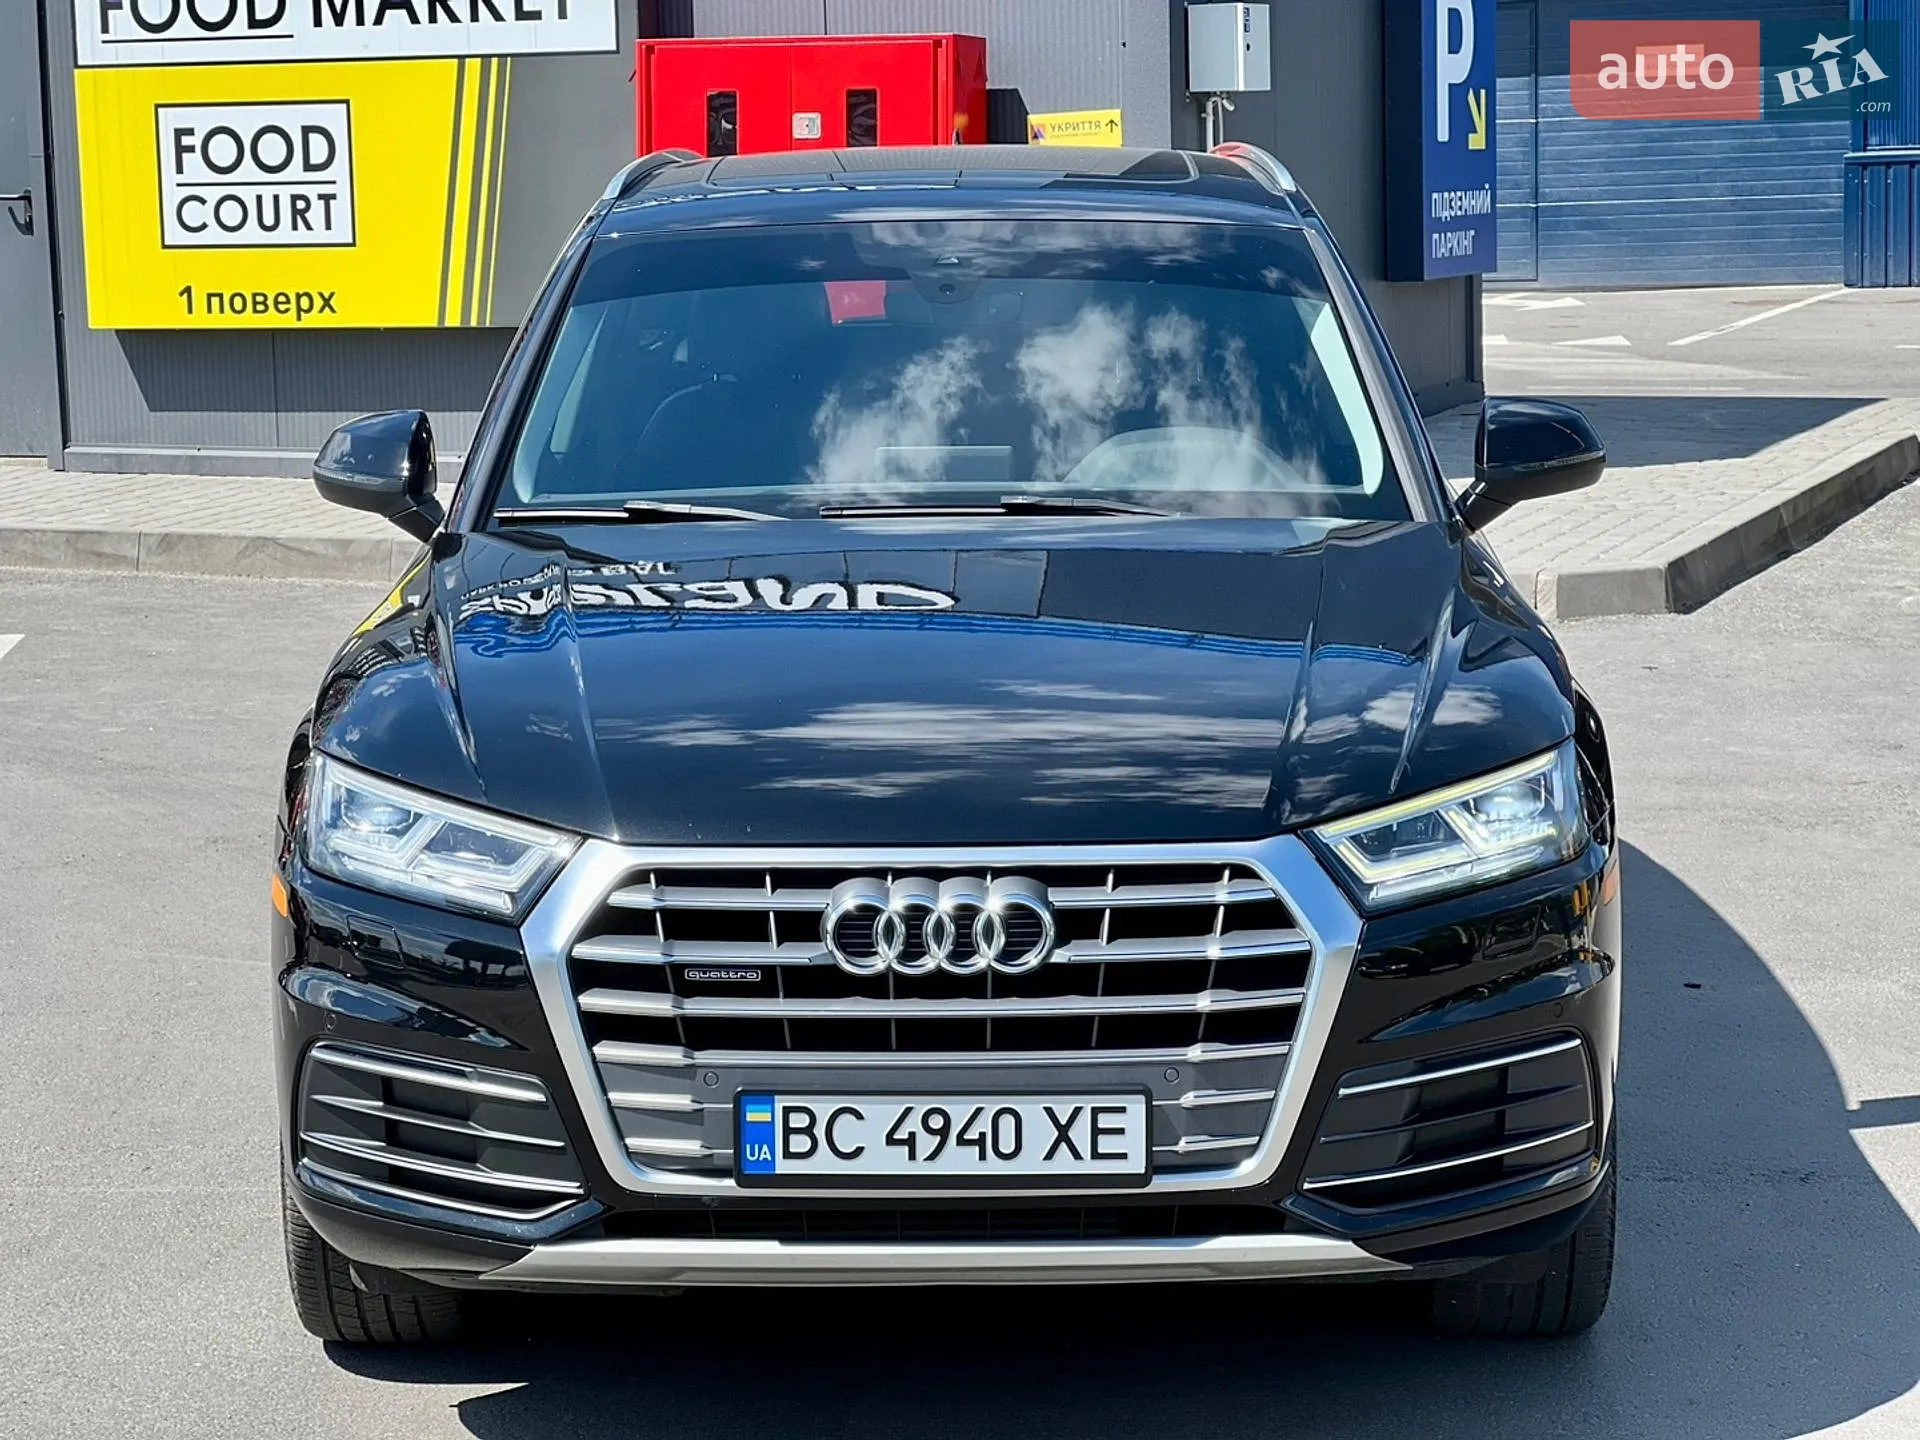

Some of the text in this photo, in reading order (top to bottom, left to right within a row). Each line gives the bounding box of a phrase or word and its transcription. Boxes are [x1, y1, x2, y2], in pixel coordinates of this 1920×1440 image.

[99, 0, 286, 34] FOOD
[1436, 0, 1475, 142] P
[1049, 120, 1102, 133] УКРИТТЯ
[173, 124, 337, 175] FOOD
[175, 193, 337, 233] COURT
[1431, 183, 1491, 222] ПІДЗЕМНИЙ
[1431, 230, 1475, 259] ПАРКІНГ
[178, 285, 337, 322] 1 поверх
[688, 970, 757, 980] quattro
[781, 1105, 1129, 1162] BC 4940 XE
[746, 1144, 772, 1162] UA
